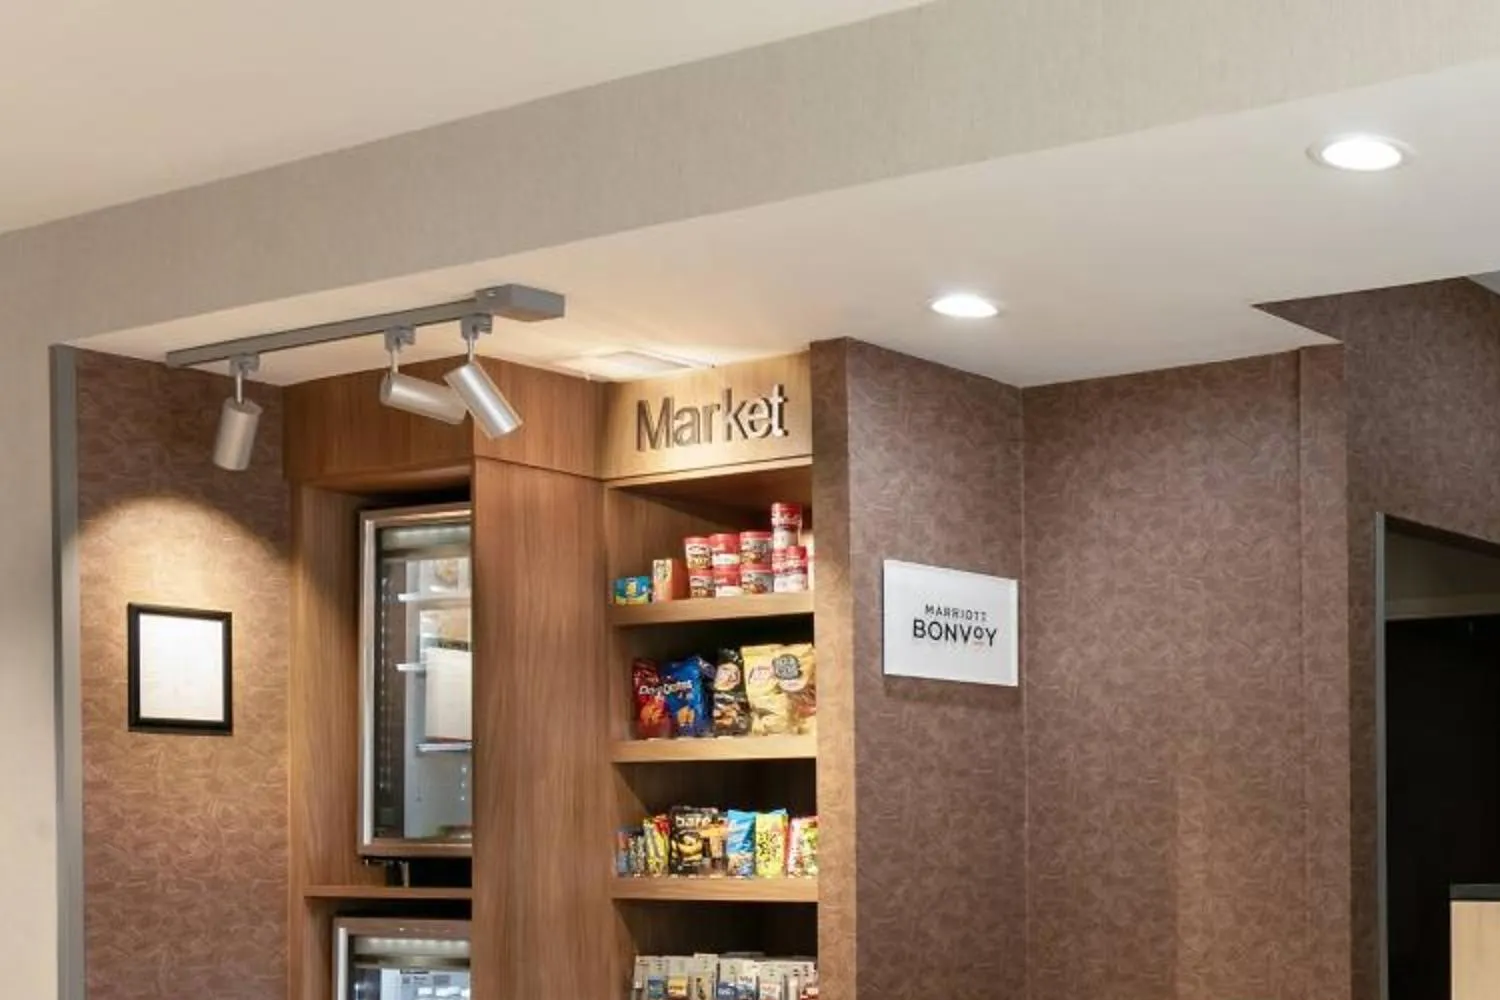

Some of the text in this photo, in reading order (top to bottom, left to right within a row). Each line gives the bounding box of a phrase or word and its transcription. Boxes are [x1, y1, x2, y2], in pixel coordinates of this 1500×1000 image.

[636, 384, 789, 452] Market
[924, 603, 987, 621] MARRIOTT
[913, 617, 997, 647] BONVOY
